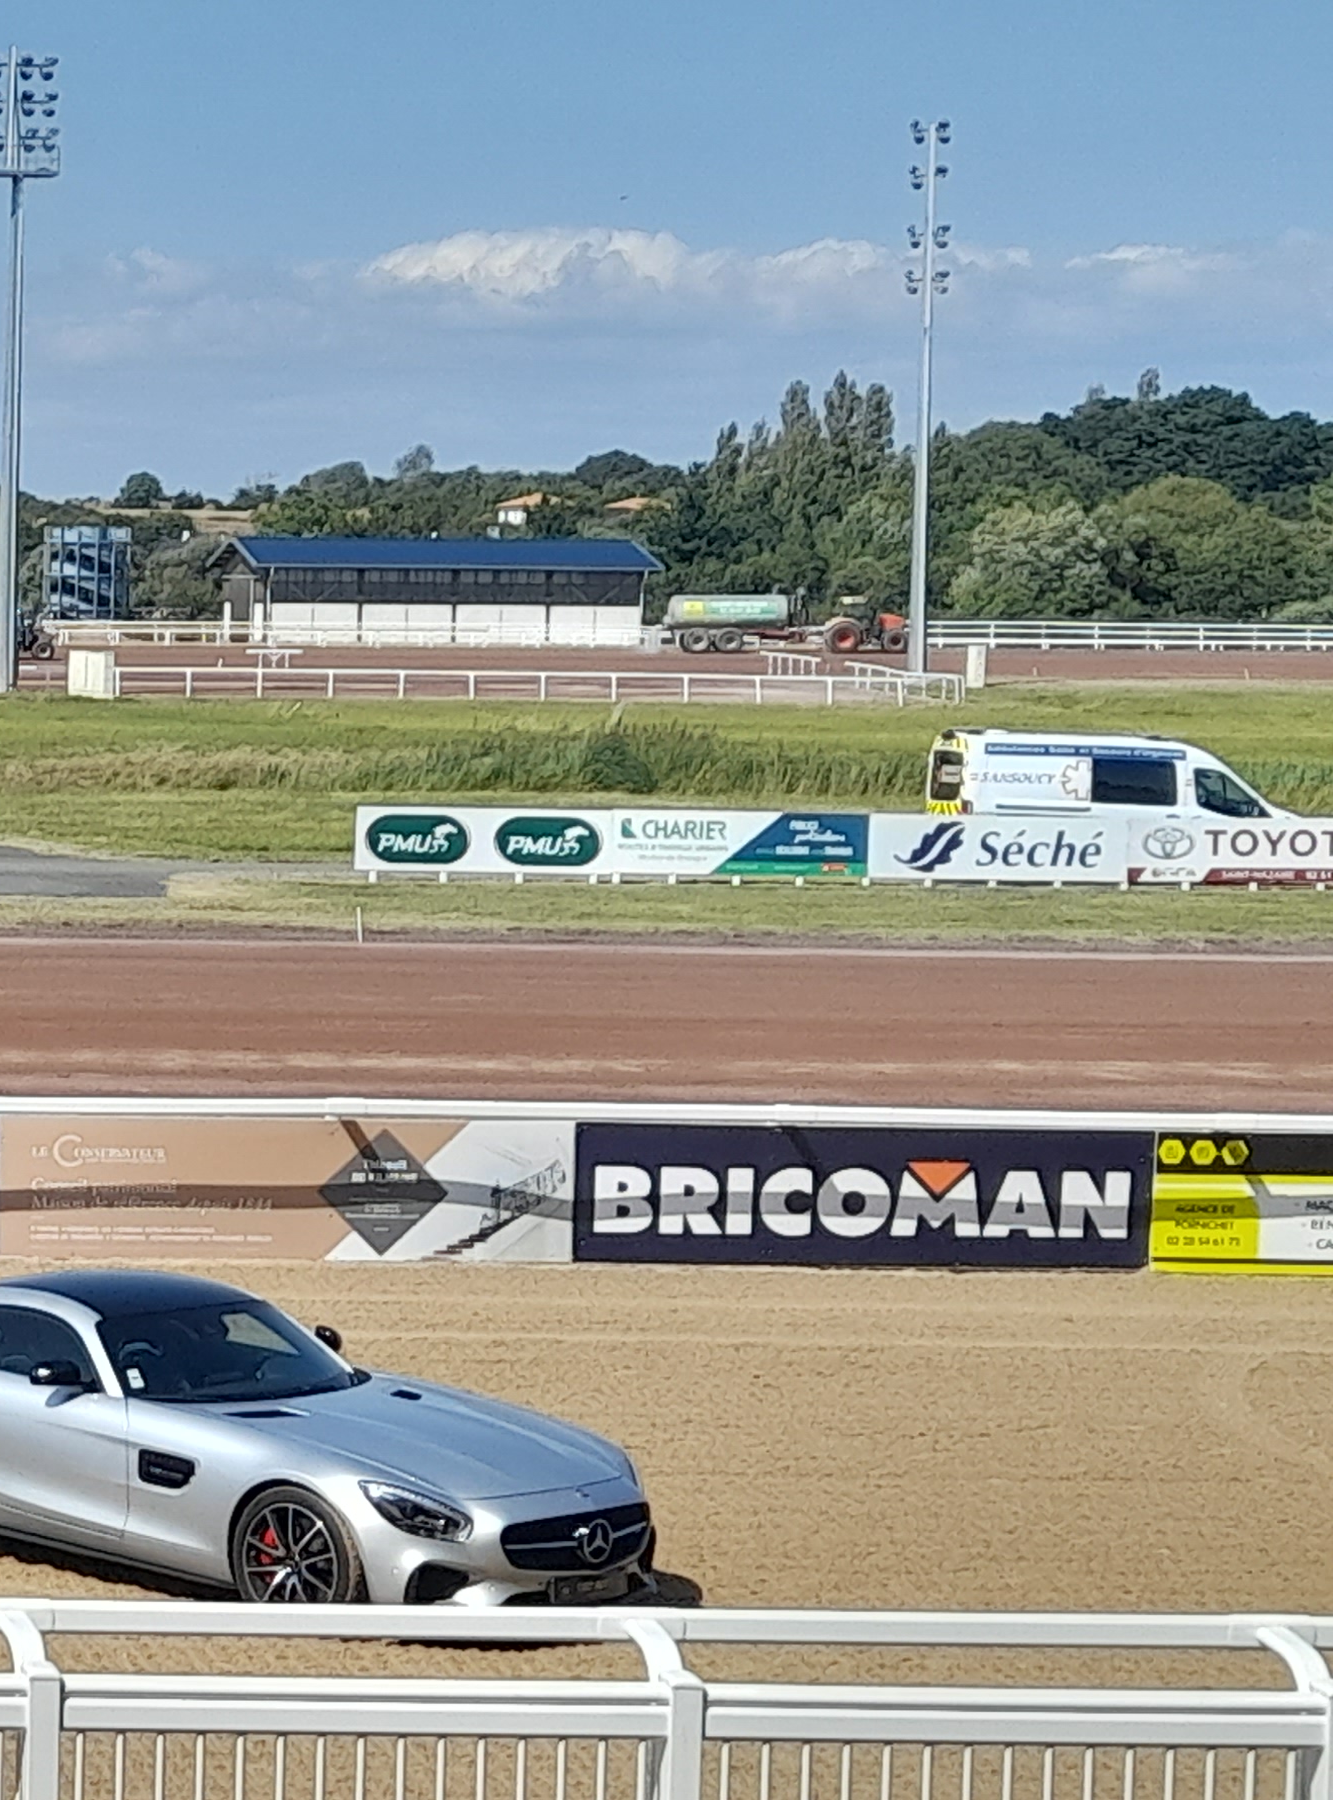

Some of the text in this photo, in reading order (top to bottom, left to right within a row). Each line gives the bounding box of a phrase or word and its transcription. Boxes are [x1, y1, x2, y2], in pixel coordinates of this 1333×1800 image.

[642, 819, 727, 841] CHARIER
[377, 832, 433, 854] PMU
[506, 835, 563, 856] PMU
[976, 830, 1104, 868] Séché
[592, 1163, 1132, 1239] BRICOMAN
[1174, 1203, 1218, 1215] AGENCE
[1174, 1220, 1235, 1231] PORNICHET
